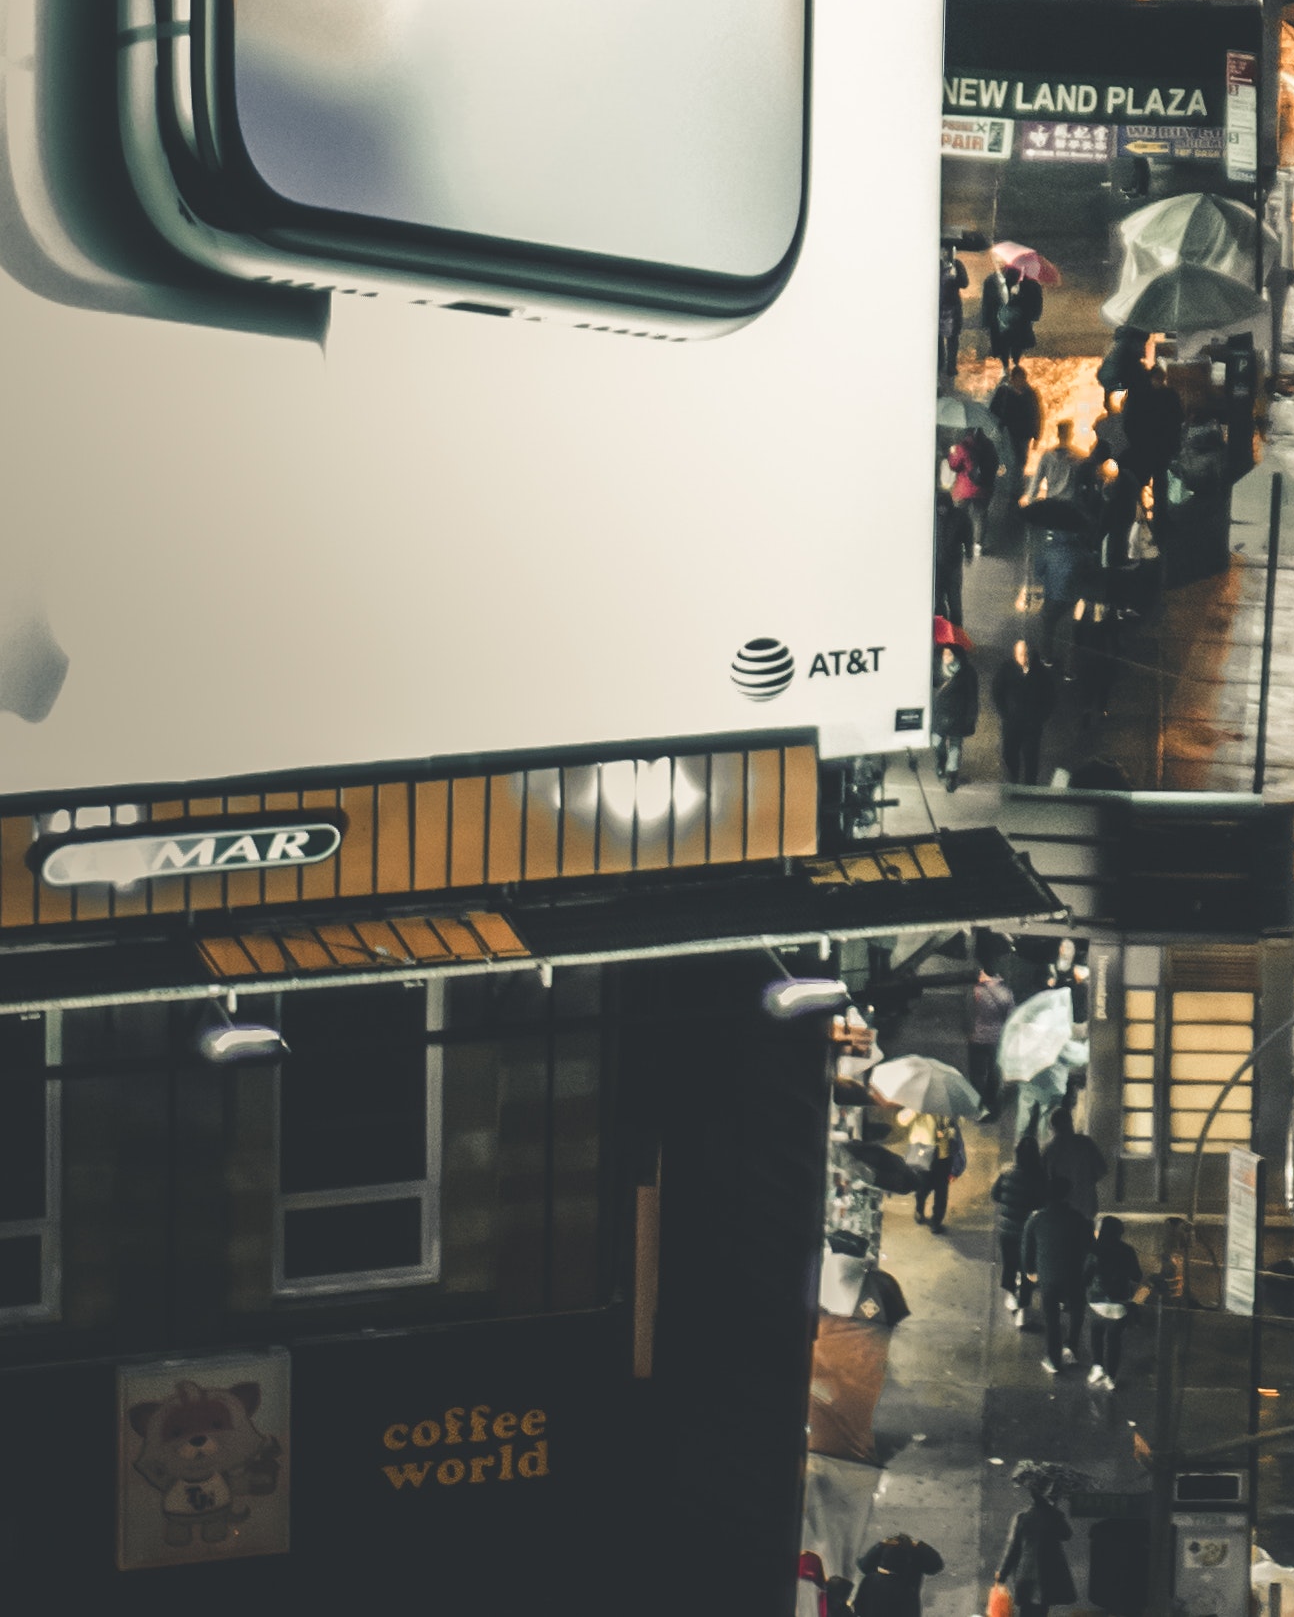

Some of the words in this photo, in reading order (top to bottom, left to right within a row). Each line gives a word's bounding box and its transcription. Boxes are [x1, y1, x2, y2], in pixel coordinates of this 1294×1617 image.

[943, 77, 1008, 109] NEW
[1014, 81, 1098, 114] LAND
[1107, 85, 1209, 117] PLAZA
[942, 133, 984, 151] PAIR
[808, 646, 885, 679] AT&T
[140, 830, 305, 873] MAR
[382, 1404, 548, 1451] coffee
[381, 1439, 551, 1490] world
